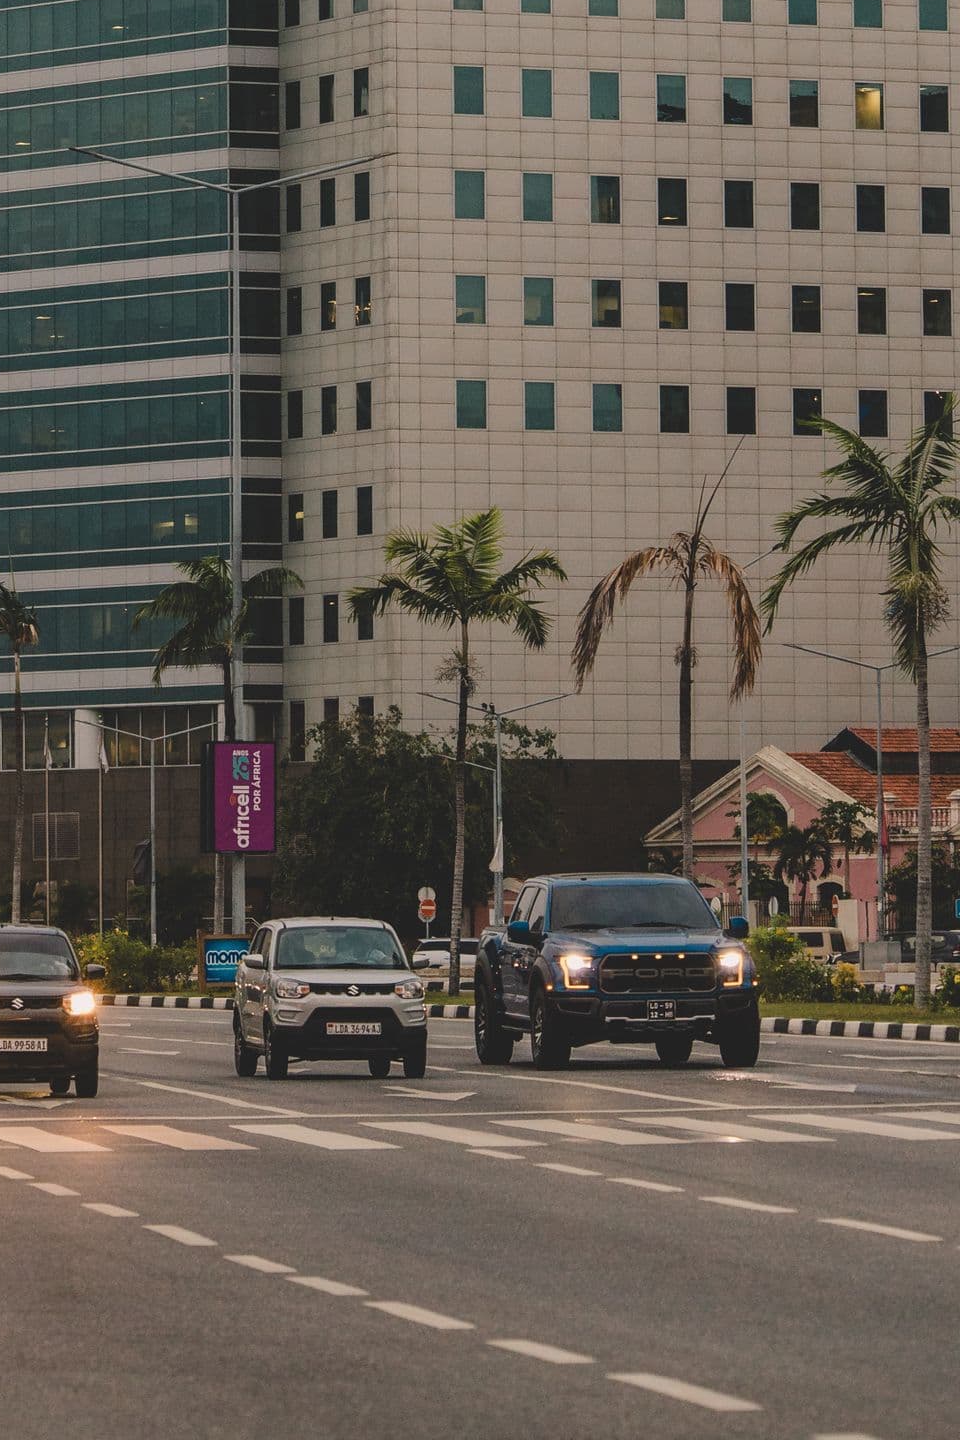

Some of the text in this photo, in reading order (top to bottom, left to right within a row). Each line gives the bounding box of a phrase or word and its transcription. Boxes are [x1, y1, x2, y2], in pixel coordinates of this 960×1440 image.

[233, 756, 250, 780] 25
[251, 750, 261, 811] POR ÁFRICA
[233, 785, 250, 848] africell
[602, 968, 714, 978] FORD
